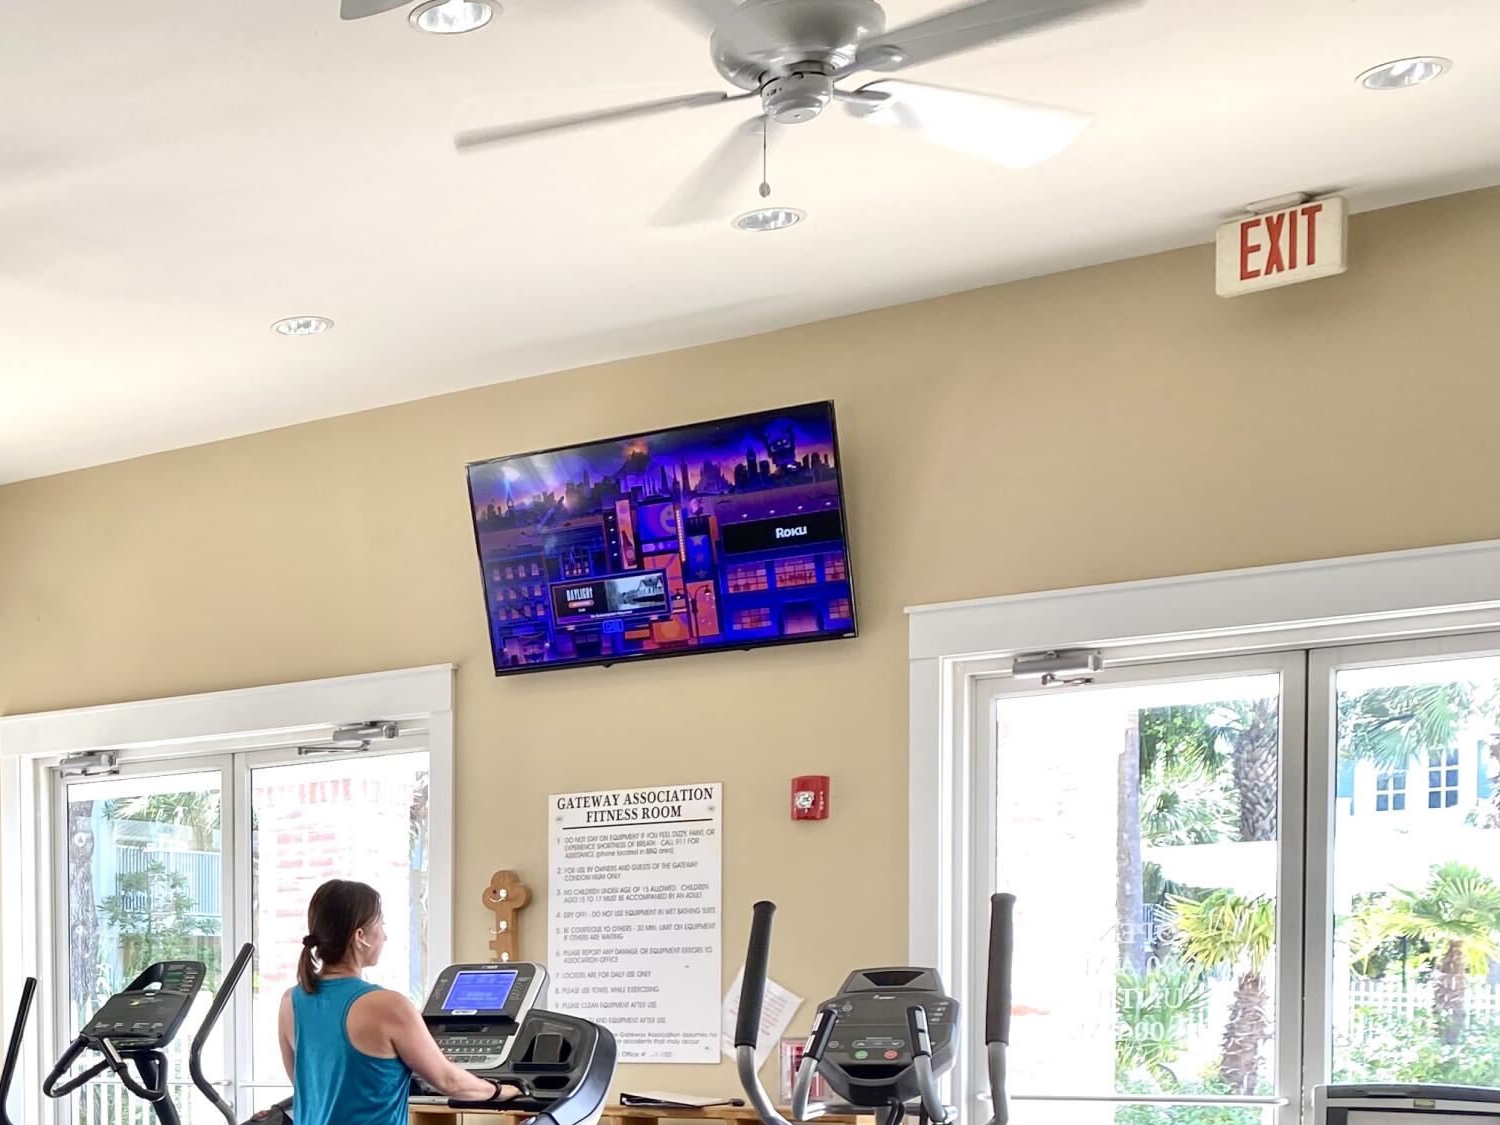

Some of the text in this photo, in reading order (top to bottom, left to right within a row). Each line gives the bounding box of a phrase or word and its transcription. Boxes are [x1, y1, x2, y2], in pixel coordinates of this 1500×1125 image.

[1240, 203, 1322, 280] EXIT
[557, 787, 714, 810] GATEWAY ASSOCIATION
[586, 805, 682, 823] FITNESS ROOM
[672, 861, 698, 869] GATEWAY
